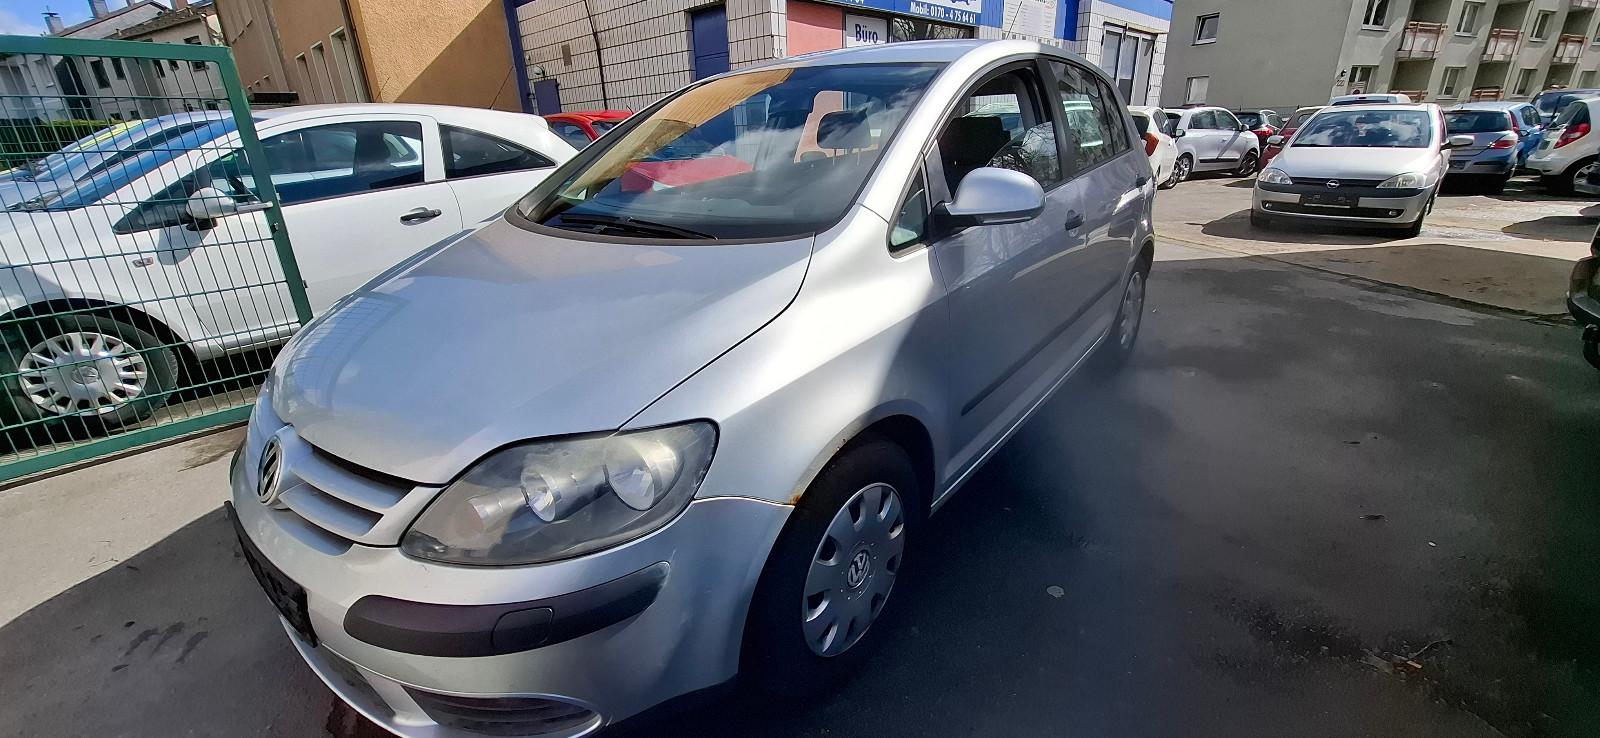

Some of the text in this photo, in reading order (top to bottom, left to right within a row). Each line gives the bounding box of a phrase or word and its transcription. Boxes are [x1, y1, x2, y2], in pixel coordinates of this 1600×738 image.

[910, 1, 929, 15] Mobil:
[930, 6, 944, 18] 0170
[954, 10, 961, 21] 75
[969, 13, 976, 24] 61
[855, 23, 878, 45] Büro
